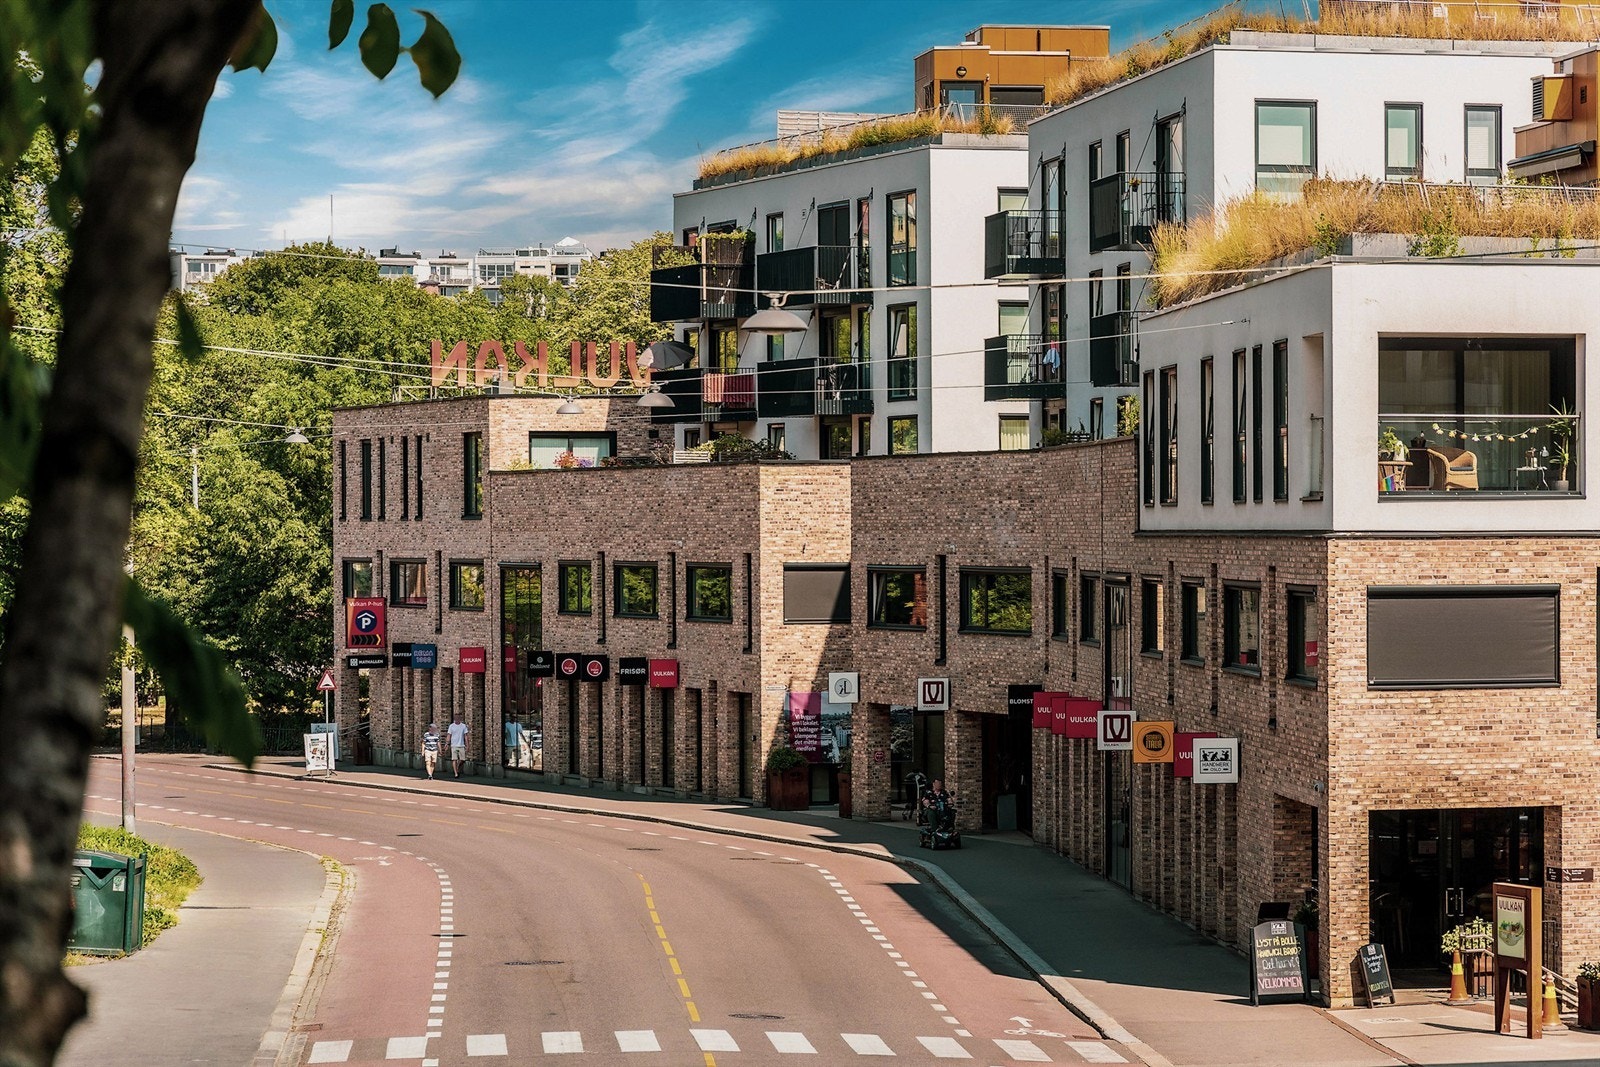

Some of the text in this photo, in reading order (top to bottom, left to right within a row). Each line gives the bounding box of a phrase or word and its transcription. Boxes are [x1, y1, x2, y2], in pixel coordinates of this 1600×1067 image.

[361, 617, 372, 629] P
[1498, 899, 1523, 913] VULKAN
[1256, 938, 1272, 948] LYST
[1273, 935, 1281, 946] PÅ
[1257, 976, 1303, 989] VELKOMMEN
